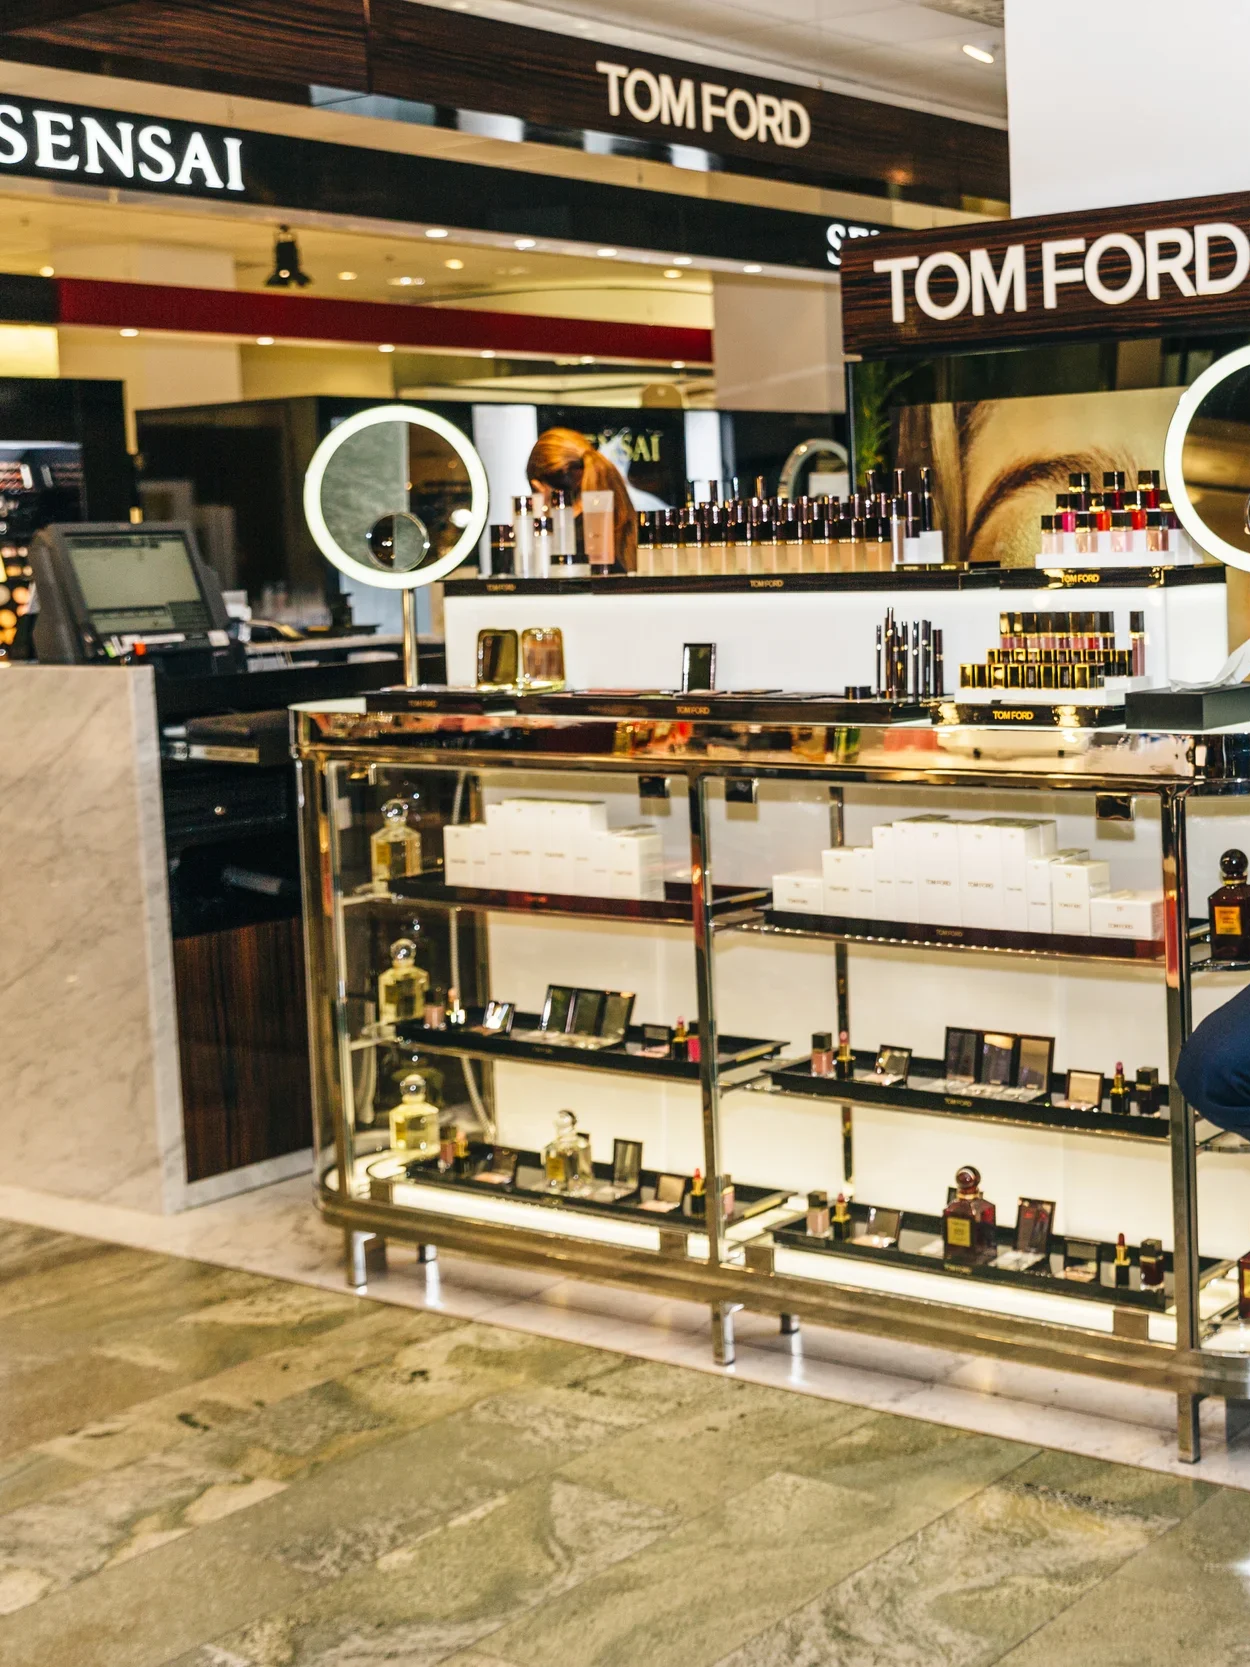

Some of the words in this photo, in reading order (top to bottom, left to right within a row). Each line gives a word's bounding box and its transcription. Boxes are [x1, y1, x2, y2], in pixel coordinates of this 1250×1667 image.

[596, 61, 696, 130] TOM
[701, 82, 812, 149] FORD
[0, 104, 246, 191] SENSAI
[873, 244, 1027, 323] TOM
[1062, 574, 1077, 583] TOM
[1078, 574, 1100, 583] FORD
[992, 710, 1010, 720] TOM
[1011, 710, 1035, 720] FORD
